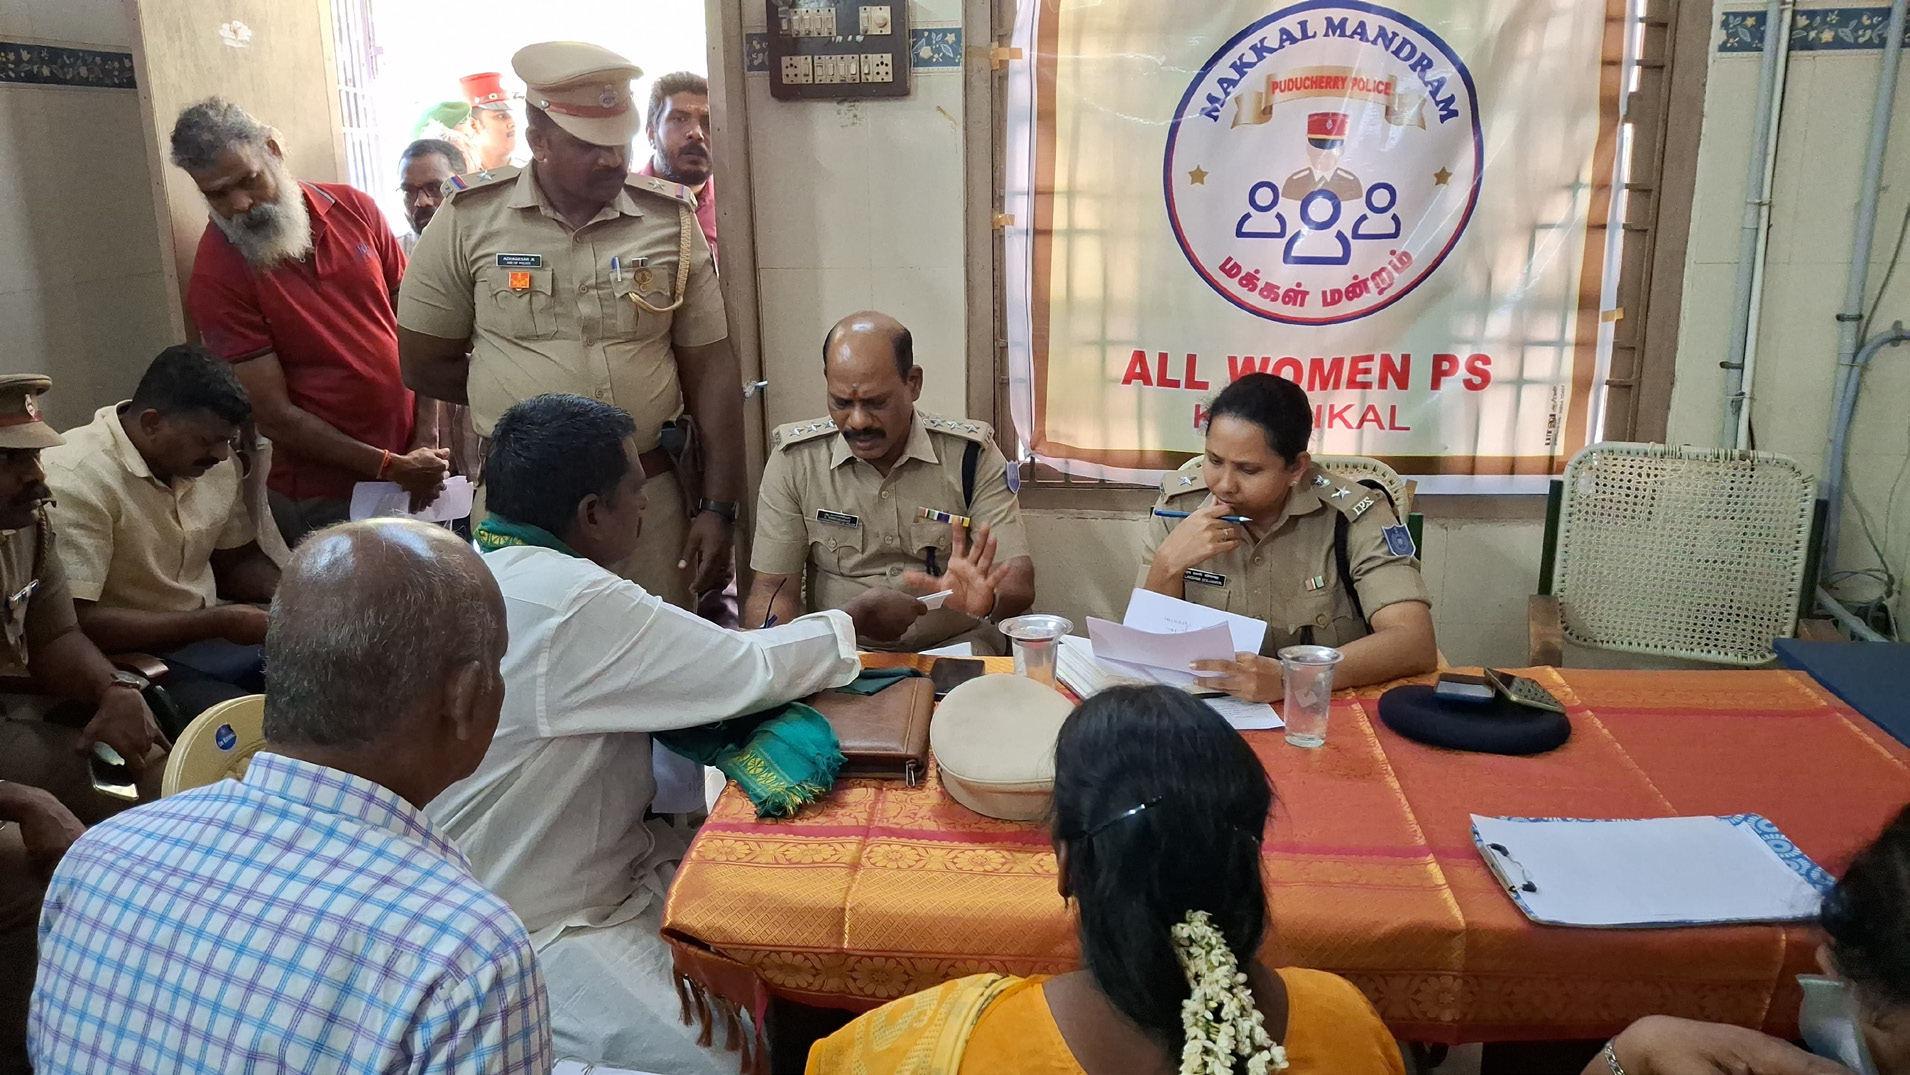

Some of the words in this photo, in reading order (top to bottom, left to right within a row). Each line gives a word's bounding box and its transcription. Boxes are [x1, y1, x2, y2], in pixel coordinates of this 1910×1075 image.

[1200, 19, 1317, 123] MAKKAL
[1322, 16, 1460, 124] MANDRAM
[1271, 75, 1348, 96] PUDUCHERRY
[1350, 77, 1392, 95] POLICE
[1218, 255, 1310, 308] மக்கள்
[1320, 249, 1413, 308] மன்றம்
[1121, 350, 1210, 391] ALL
[1430, 353, 1493, 392] PS
